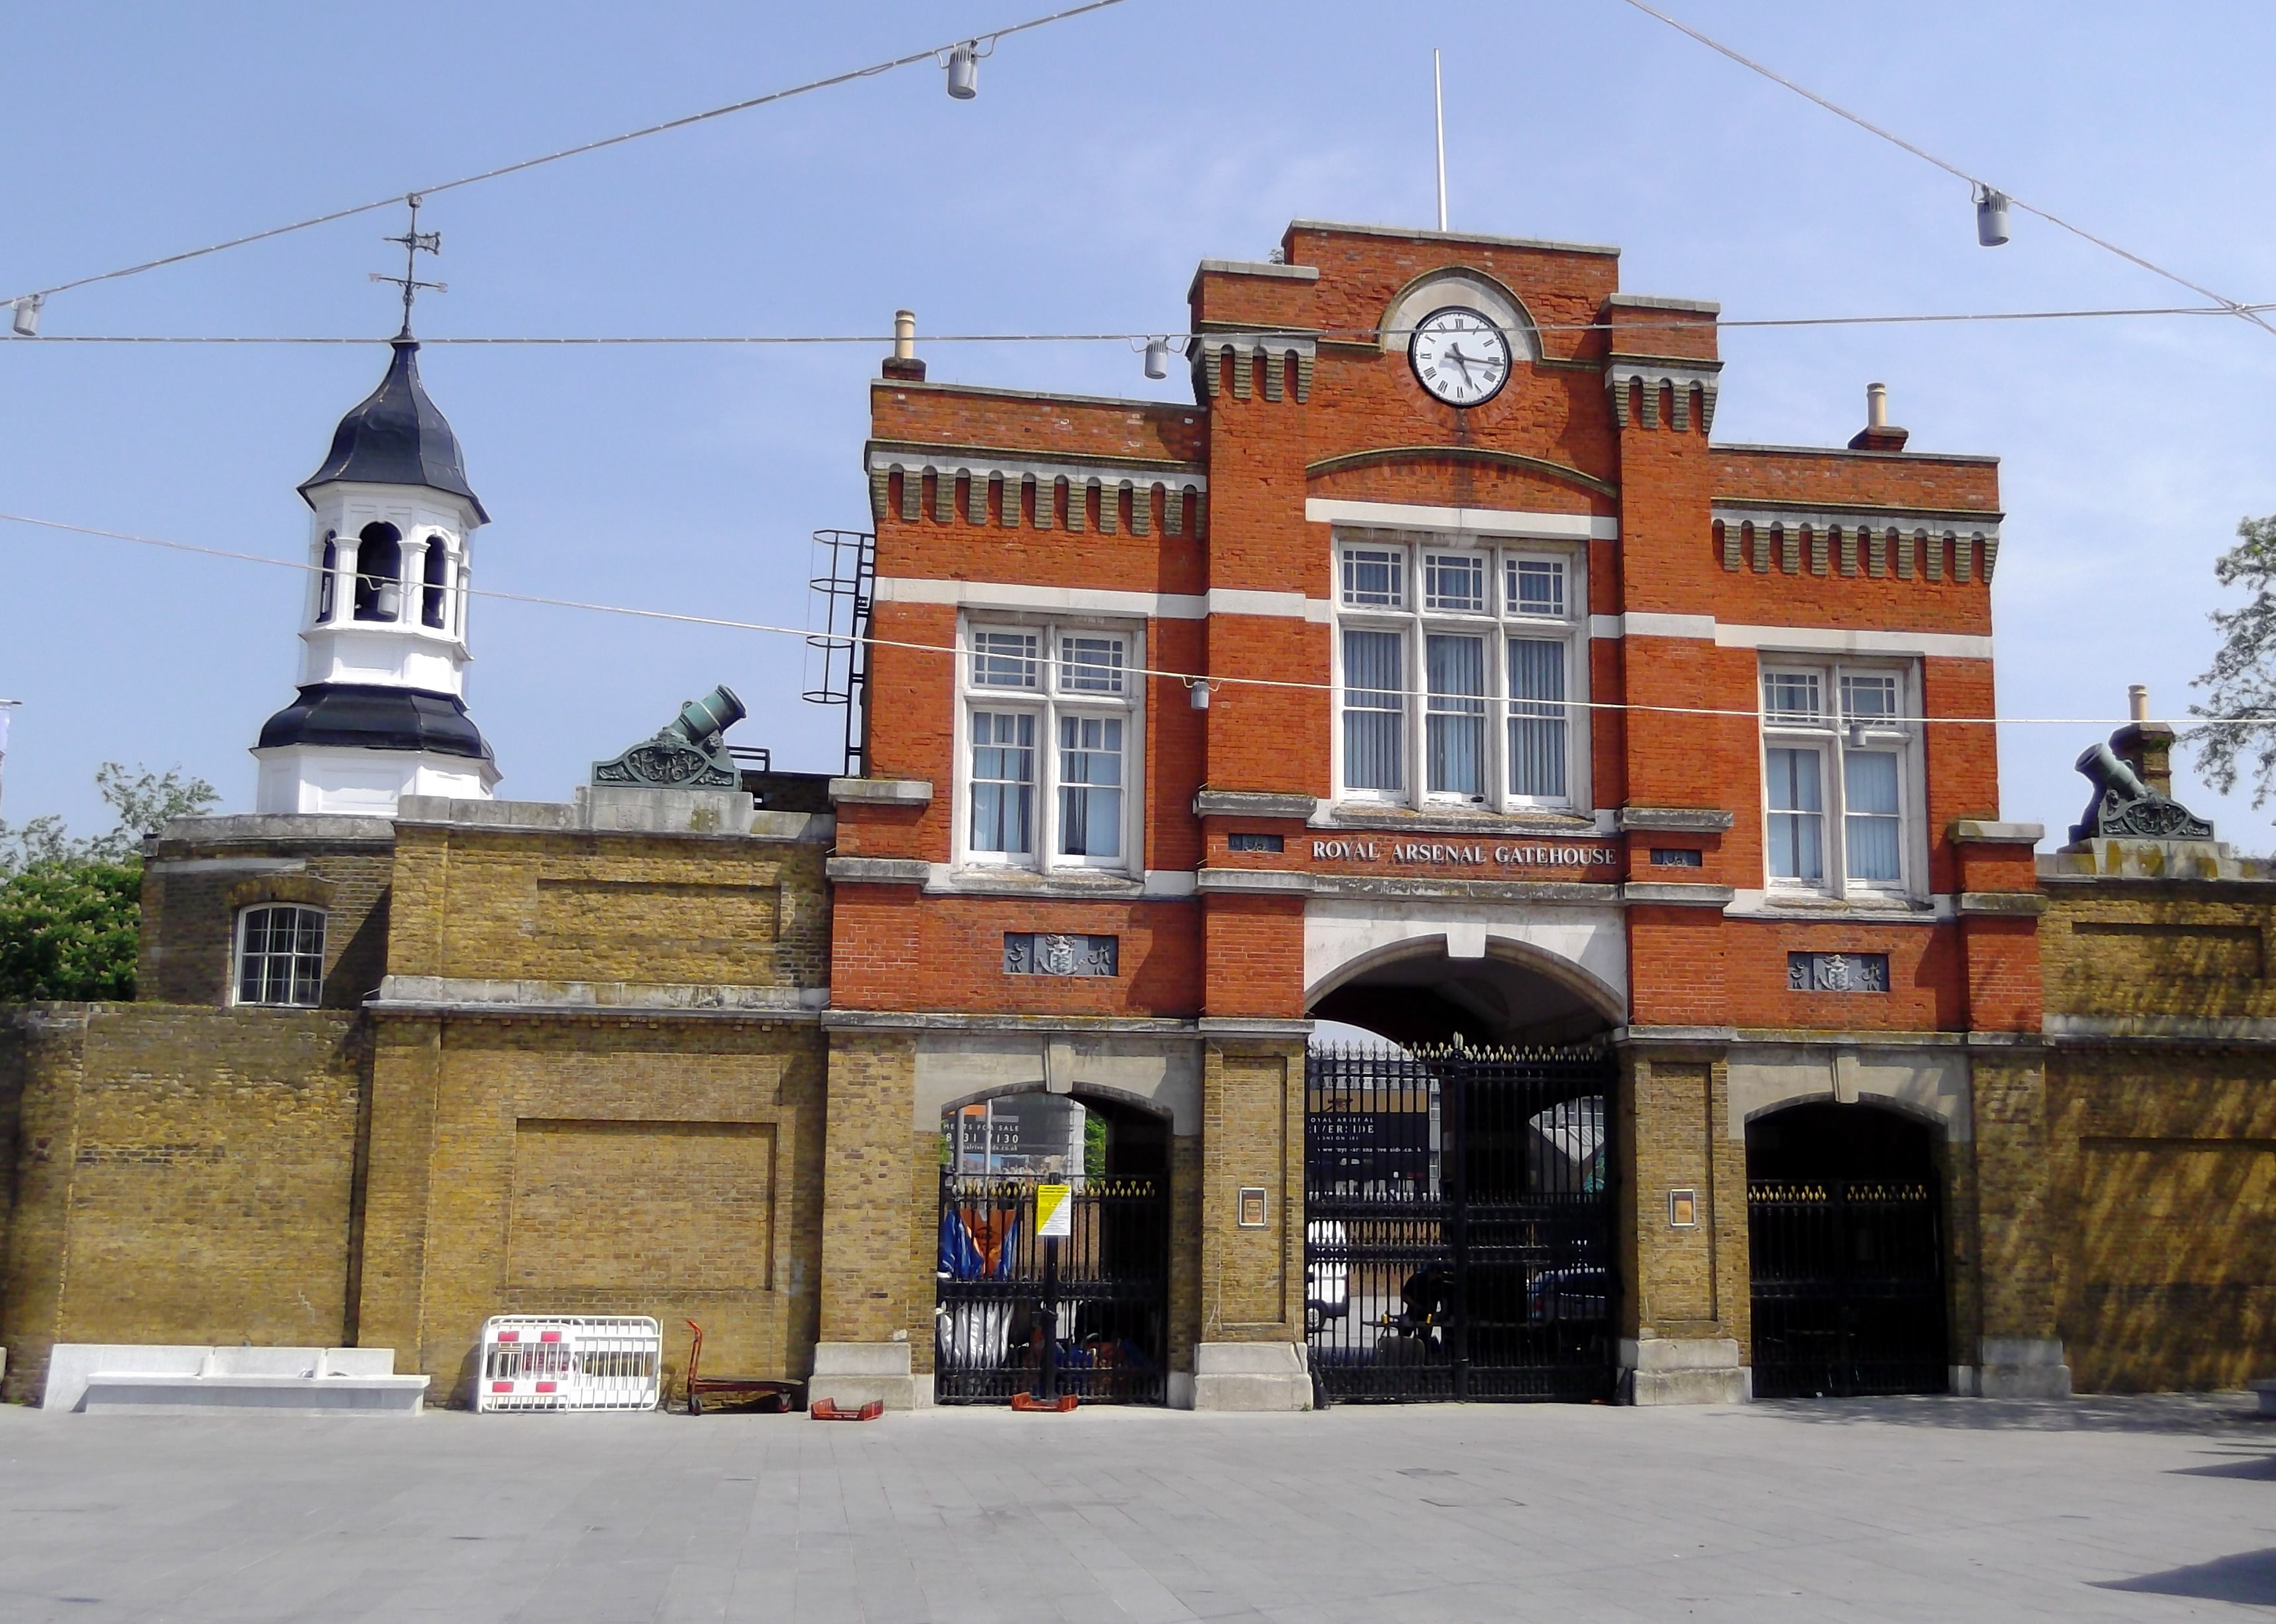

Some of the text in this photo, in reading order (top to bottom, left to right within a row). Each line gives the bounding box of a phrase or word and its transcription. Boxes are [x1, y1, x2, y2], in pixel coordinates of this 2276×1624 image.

[1313, 840, 1616, 865] ROYAL ARSENAL GATEHOUSE
